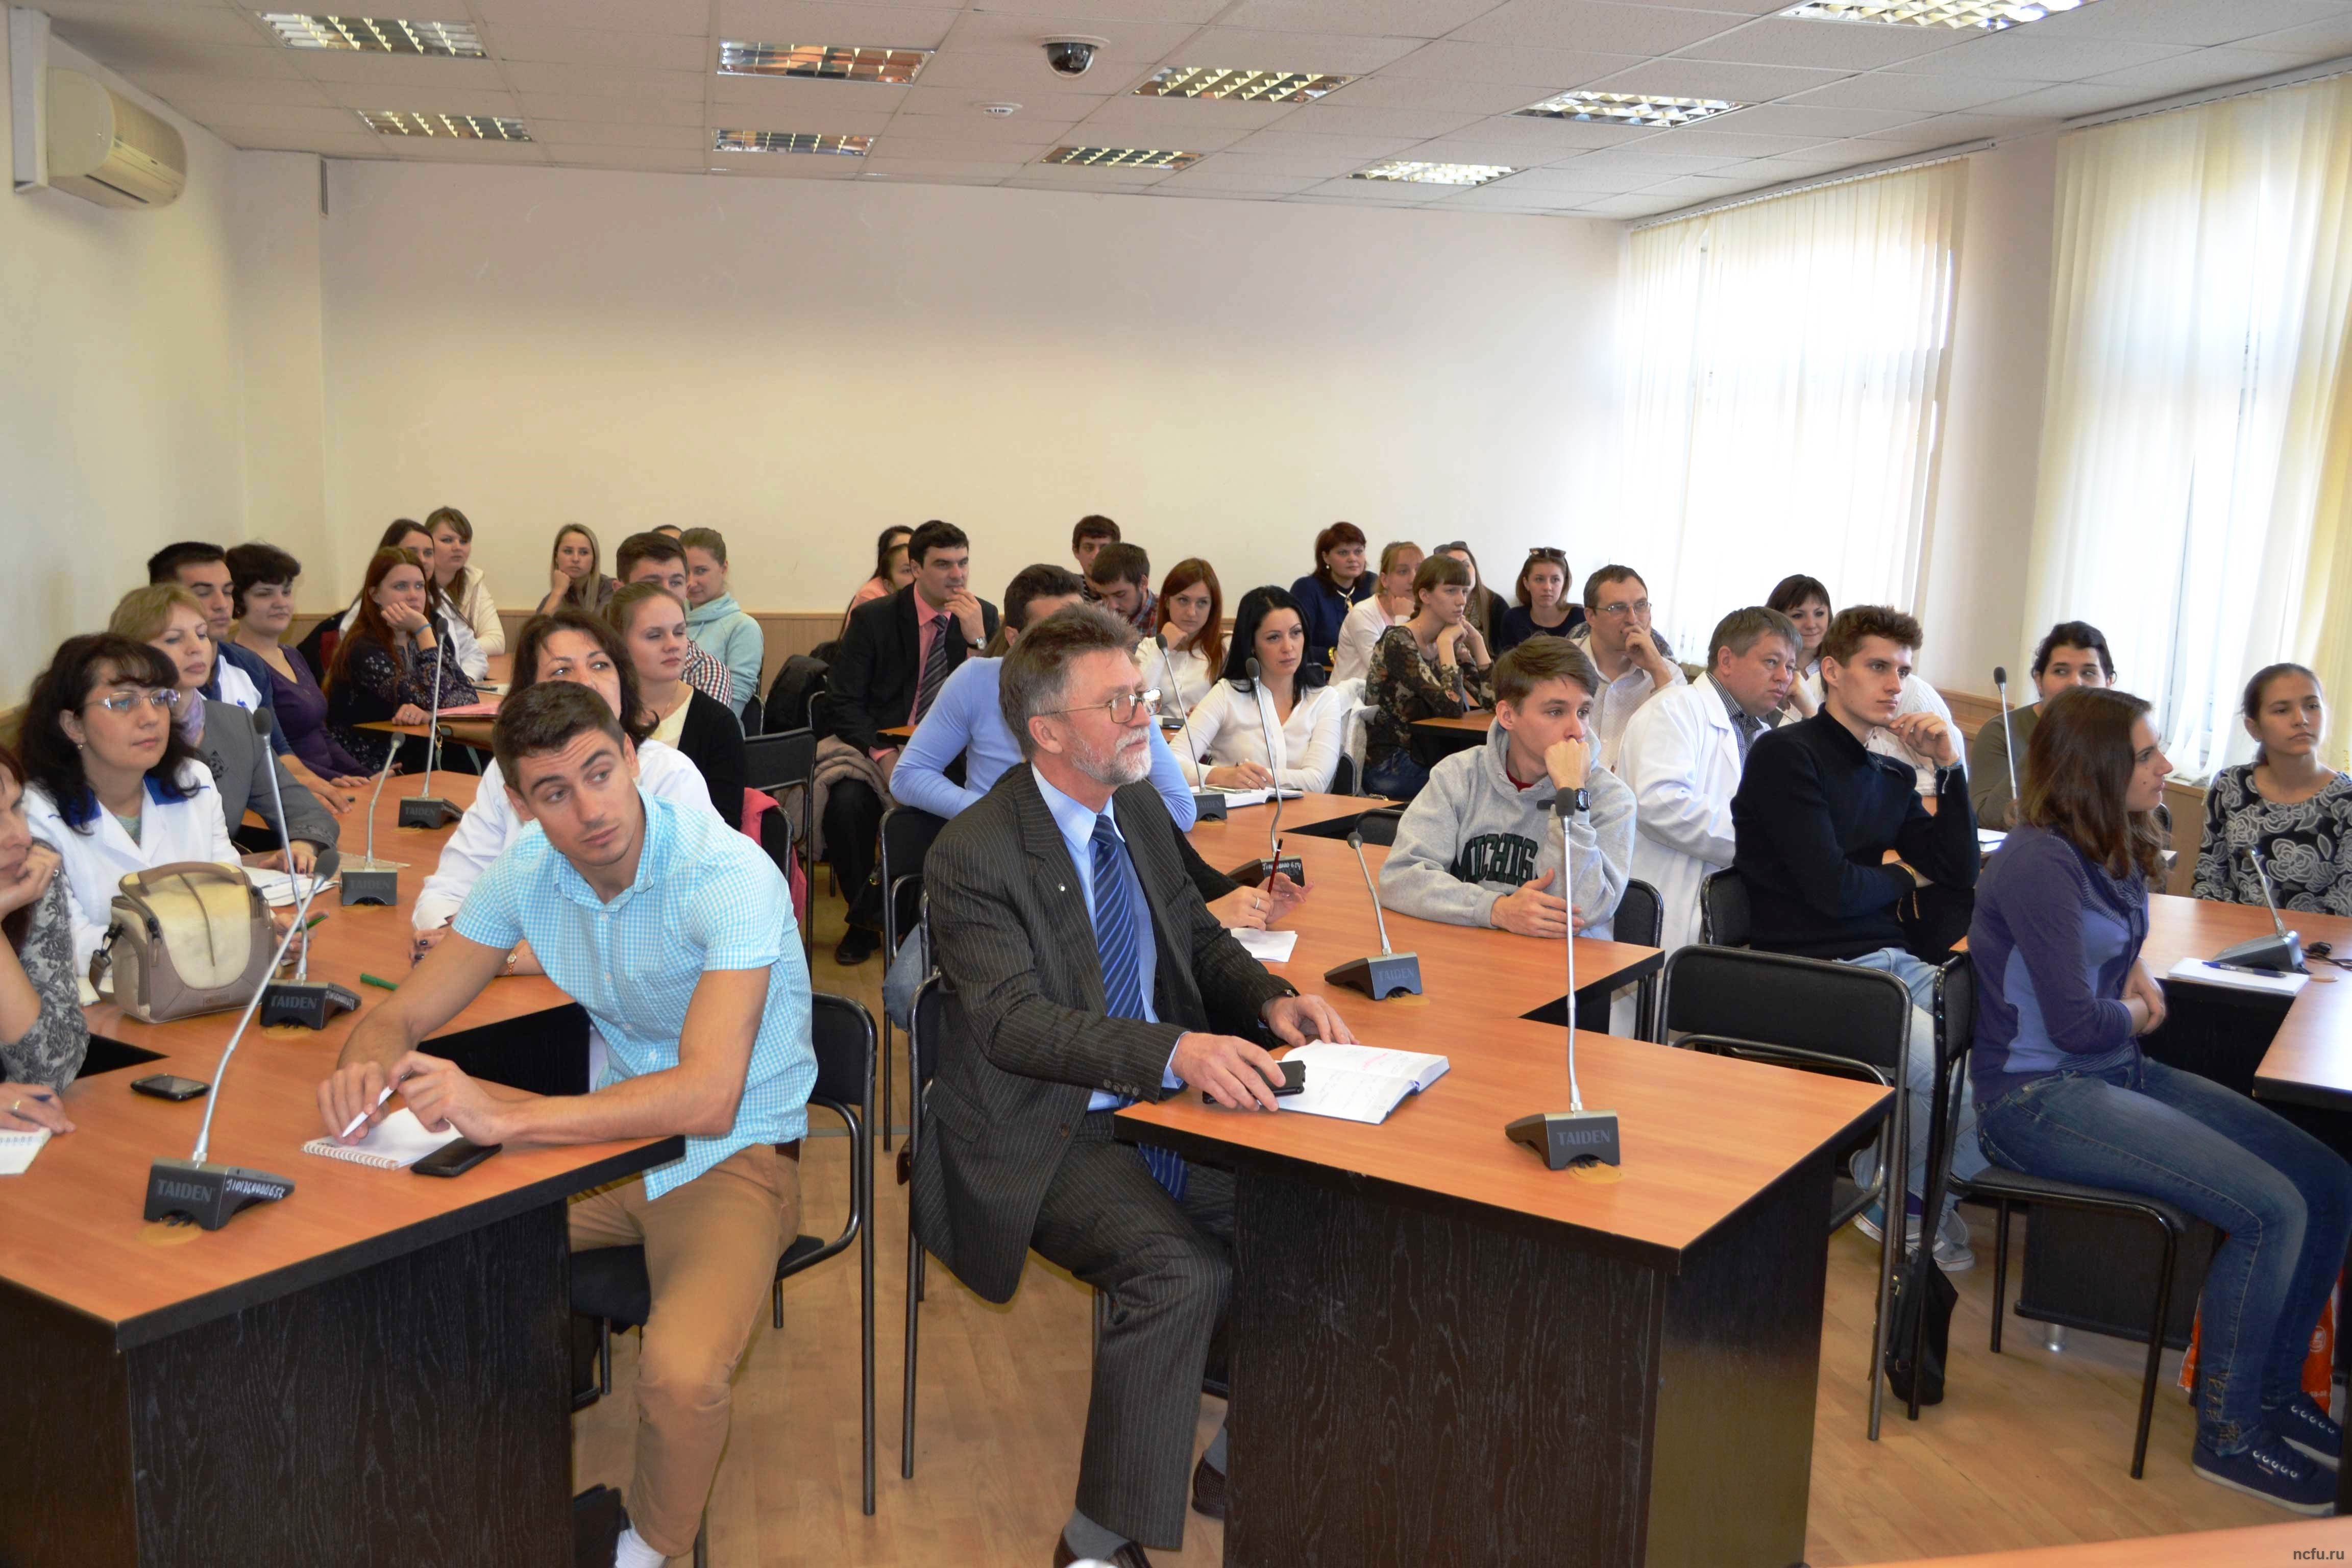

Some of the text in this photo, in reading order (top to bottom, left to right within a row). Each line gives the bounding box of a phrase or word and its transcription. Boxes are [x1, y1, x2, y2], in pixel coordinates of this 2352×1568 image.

[405, 806, 435, 816] TAIDEN
[1450, 833, 1538, 887] MICHIG
[350, 879, 391, 890] TAIDEN
[1378, 968, 1414, 982] TAIDEN
[271, 996, 317, 1009] TAIDEN
[1557, 1130, 1610, 1146] TAIDEN
[157, 1179, 212, 1202] TAIDEN
